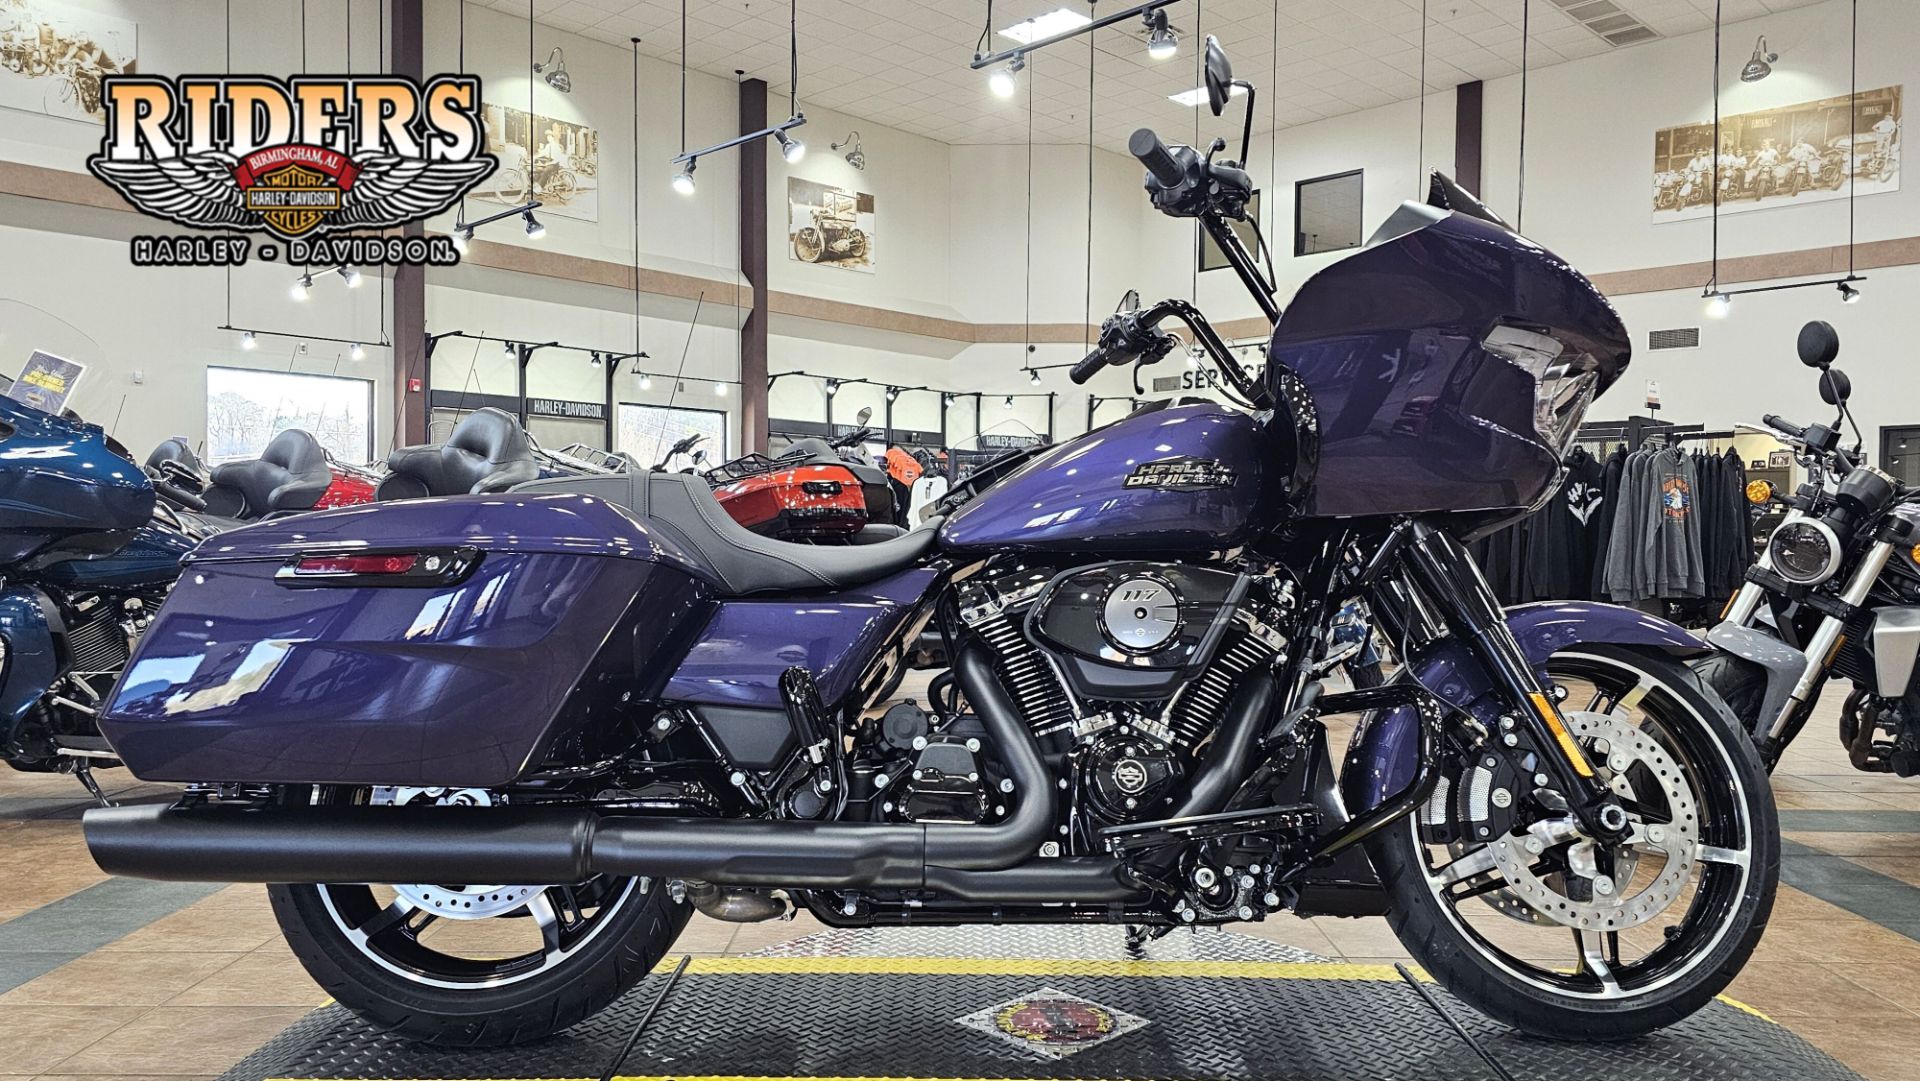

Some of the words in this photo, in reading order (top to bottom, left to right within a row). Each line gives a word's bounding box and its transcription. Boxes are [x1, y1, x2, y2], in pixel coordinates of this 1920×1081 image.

[1182, 363, 1266, 390] SERV
[534, 399, 603, 418] HARLEY-DAVIDSON
[1120, 588, 1162, 602] 117
